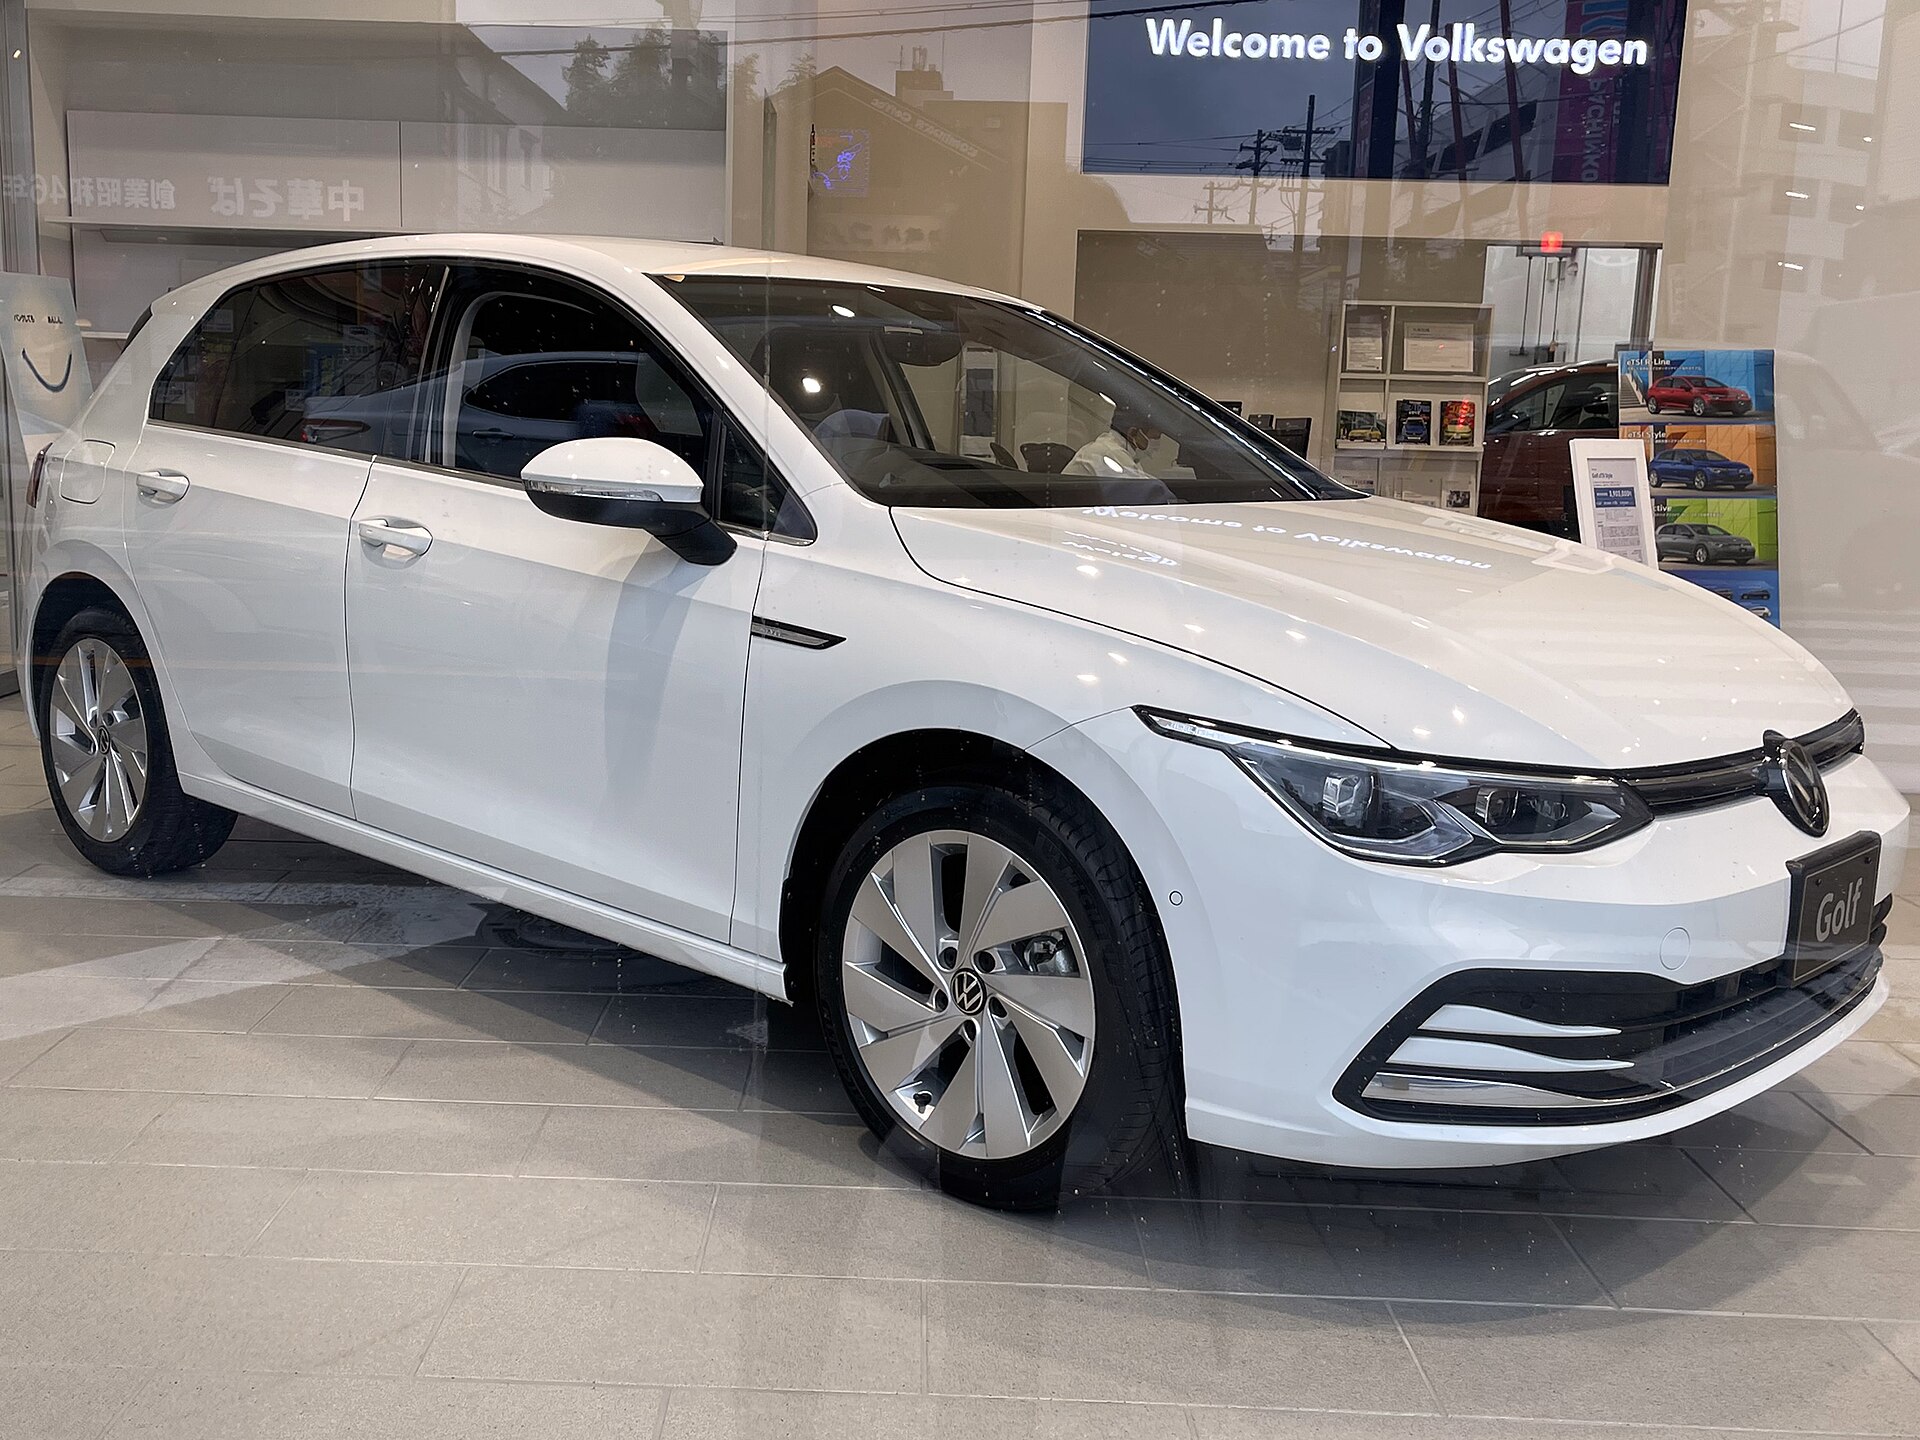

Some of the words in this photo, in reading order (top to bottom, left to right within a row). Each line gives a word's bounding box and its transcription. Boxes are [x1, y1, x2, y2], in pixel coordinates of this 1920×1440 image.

[1145, 17, 1331, 60] Welcome
[1343, 27, 1384, 61] to
[1396, 22, 1648, 75] Volkswagen
[1652, 504, 1673, 512] ctive
[1815, 876, 1863, 943] Golf
